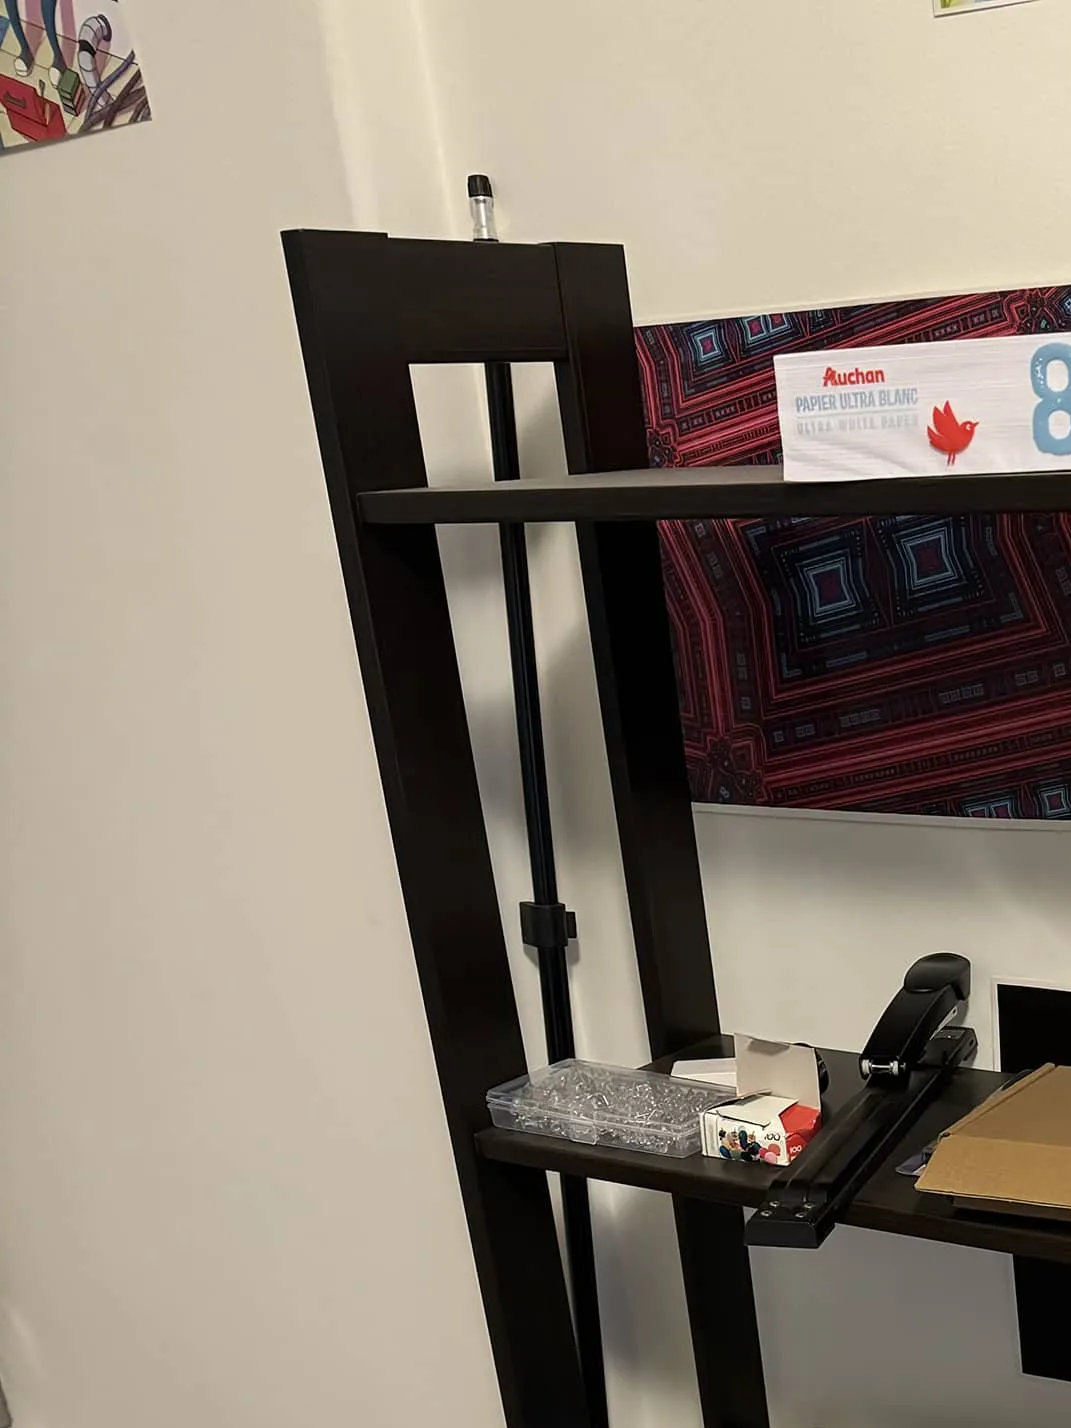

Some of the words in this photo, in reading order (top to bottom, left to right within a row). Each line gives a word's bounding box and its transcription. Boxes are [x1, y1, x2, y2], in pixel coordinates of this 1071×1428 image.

[822, 366, 886, 388] Auchan
[795, 394, 838, 413] PAPIER
[840, 391, 876, 410] ULTRA
[879, 388, 918, 406] BLANC
